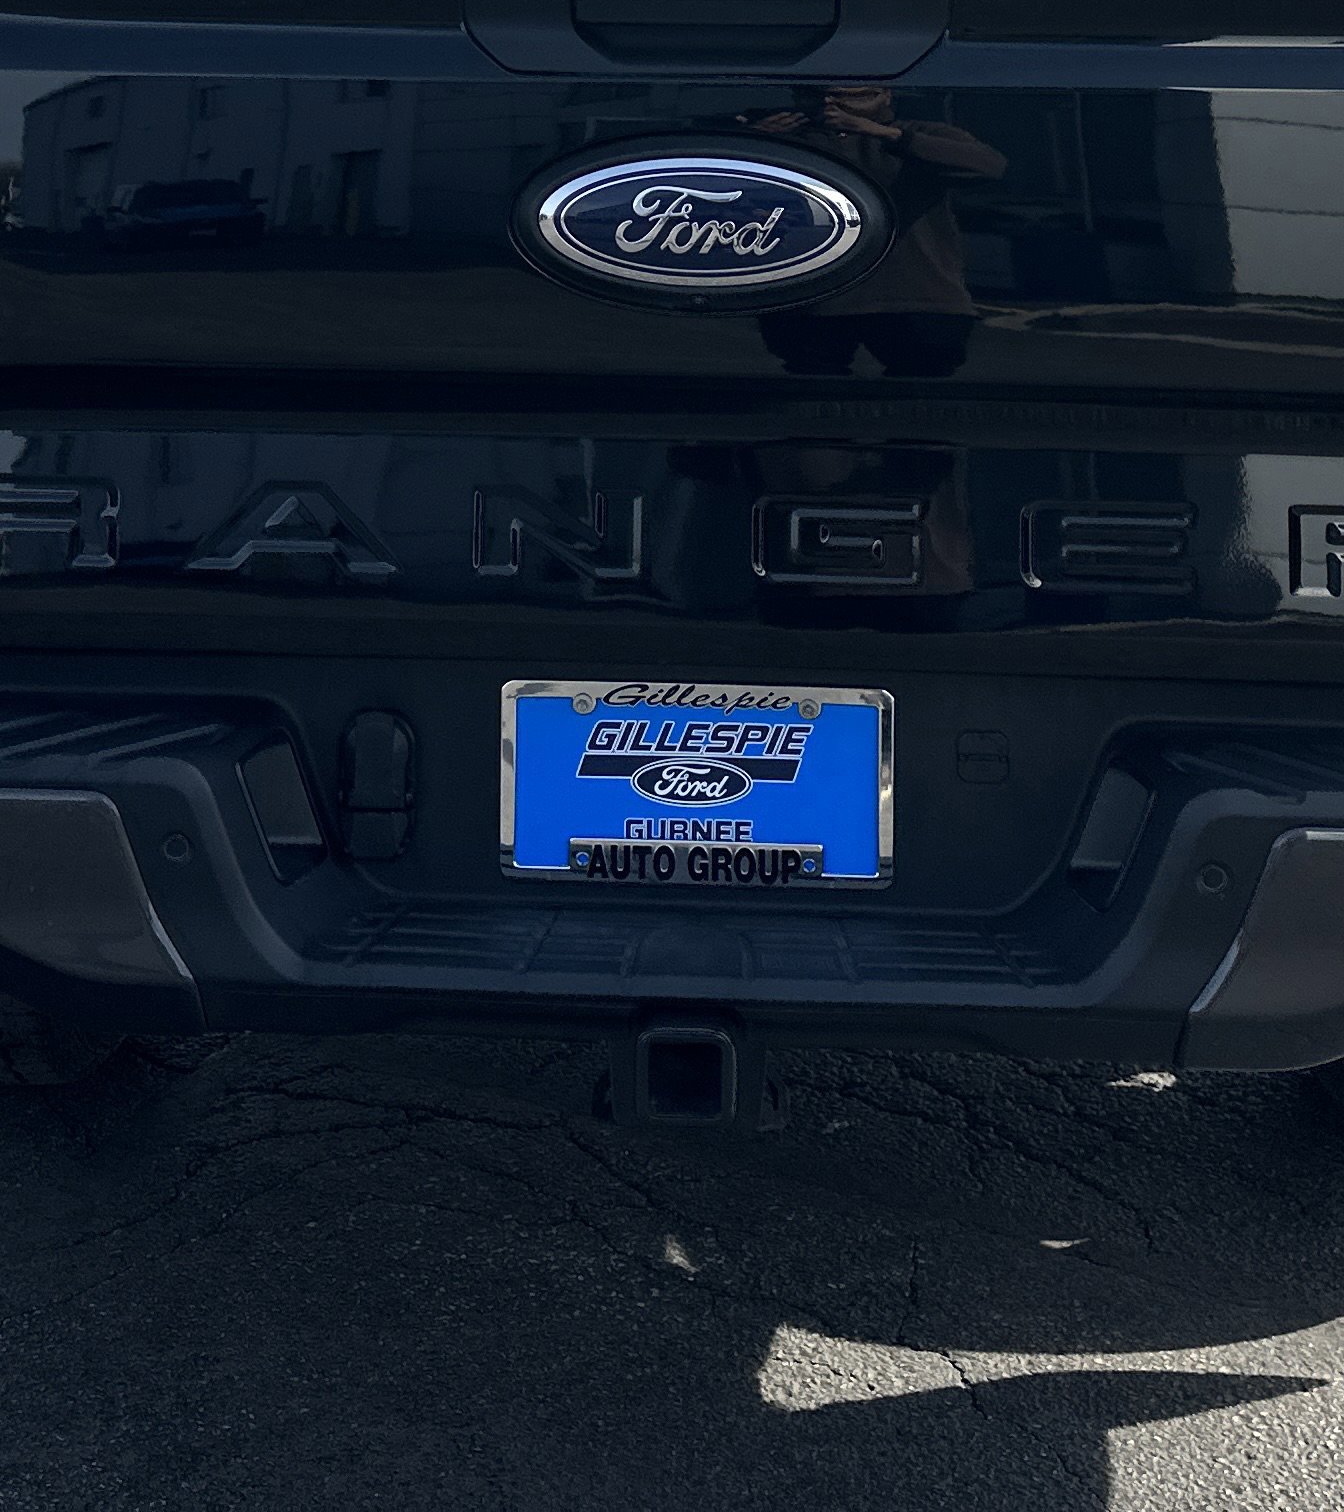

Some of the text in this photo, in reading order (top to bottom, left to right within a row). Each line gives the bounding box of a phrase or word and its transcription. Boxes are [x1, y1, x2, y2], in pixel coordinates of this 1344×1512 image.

[614, 185, 785, 256] Ford
[602, 683, 792, 716] Gillespie
[586, 720, 814, 757] GILLESPIE
[655, 765, 729, 798] Ford
[623, 817, 754, 842] GURNEE
[586, 843, 803, 885] AUTO GROUP
